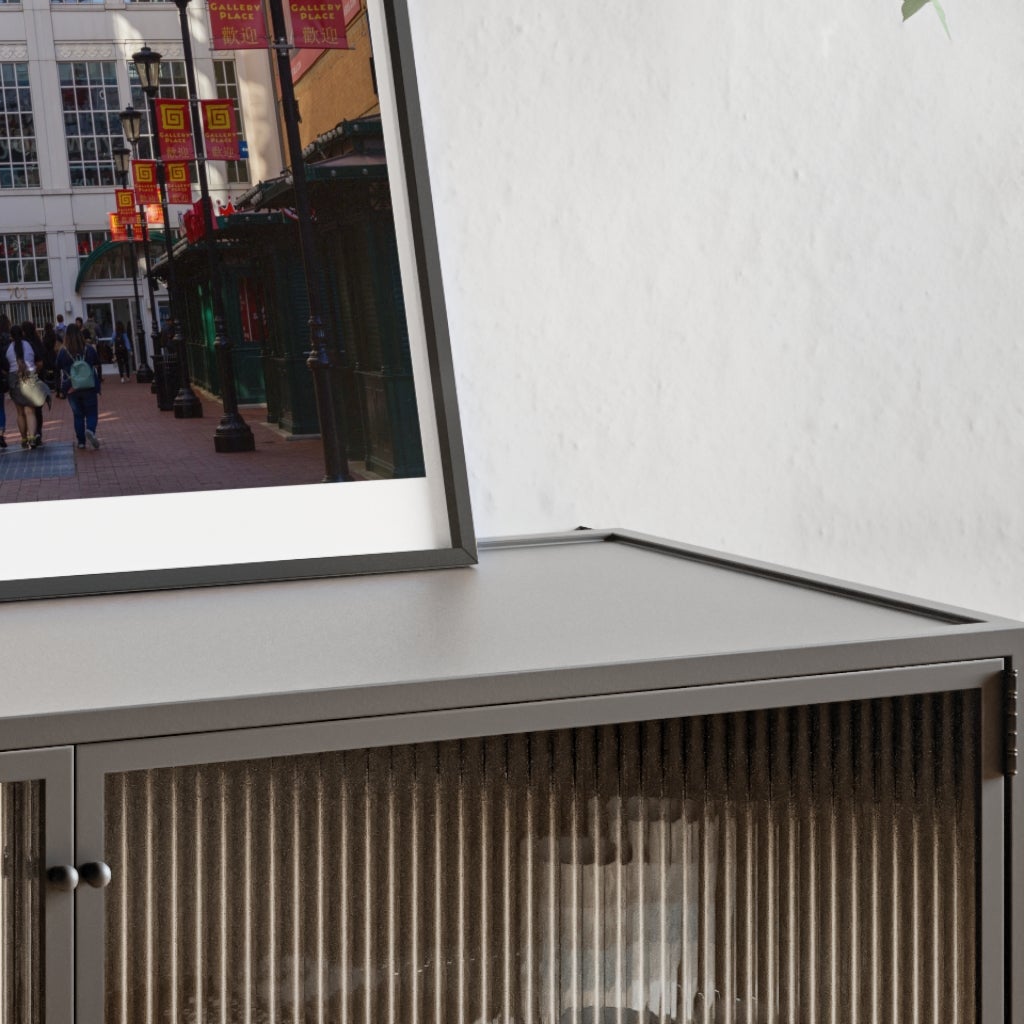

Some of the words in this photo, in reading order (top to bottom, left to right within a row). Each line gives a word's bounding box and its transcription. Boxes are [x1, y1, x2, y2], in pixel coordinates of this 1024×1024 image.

[210, 2, 261, 11] GALLERY
[291, 3, 341, 12] GALLERY
[219, 11, 254, 20] PLACE
[300, 12, 335, 20] PLACE
[7, 286, 29, 300] 701
